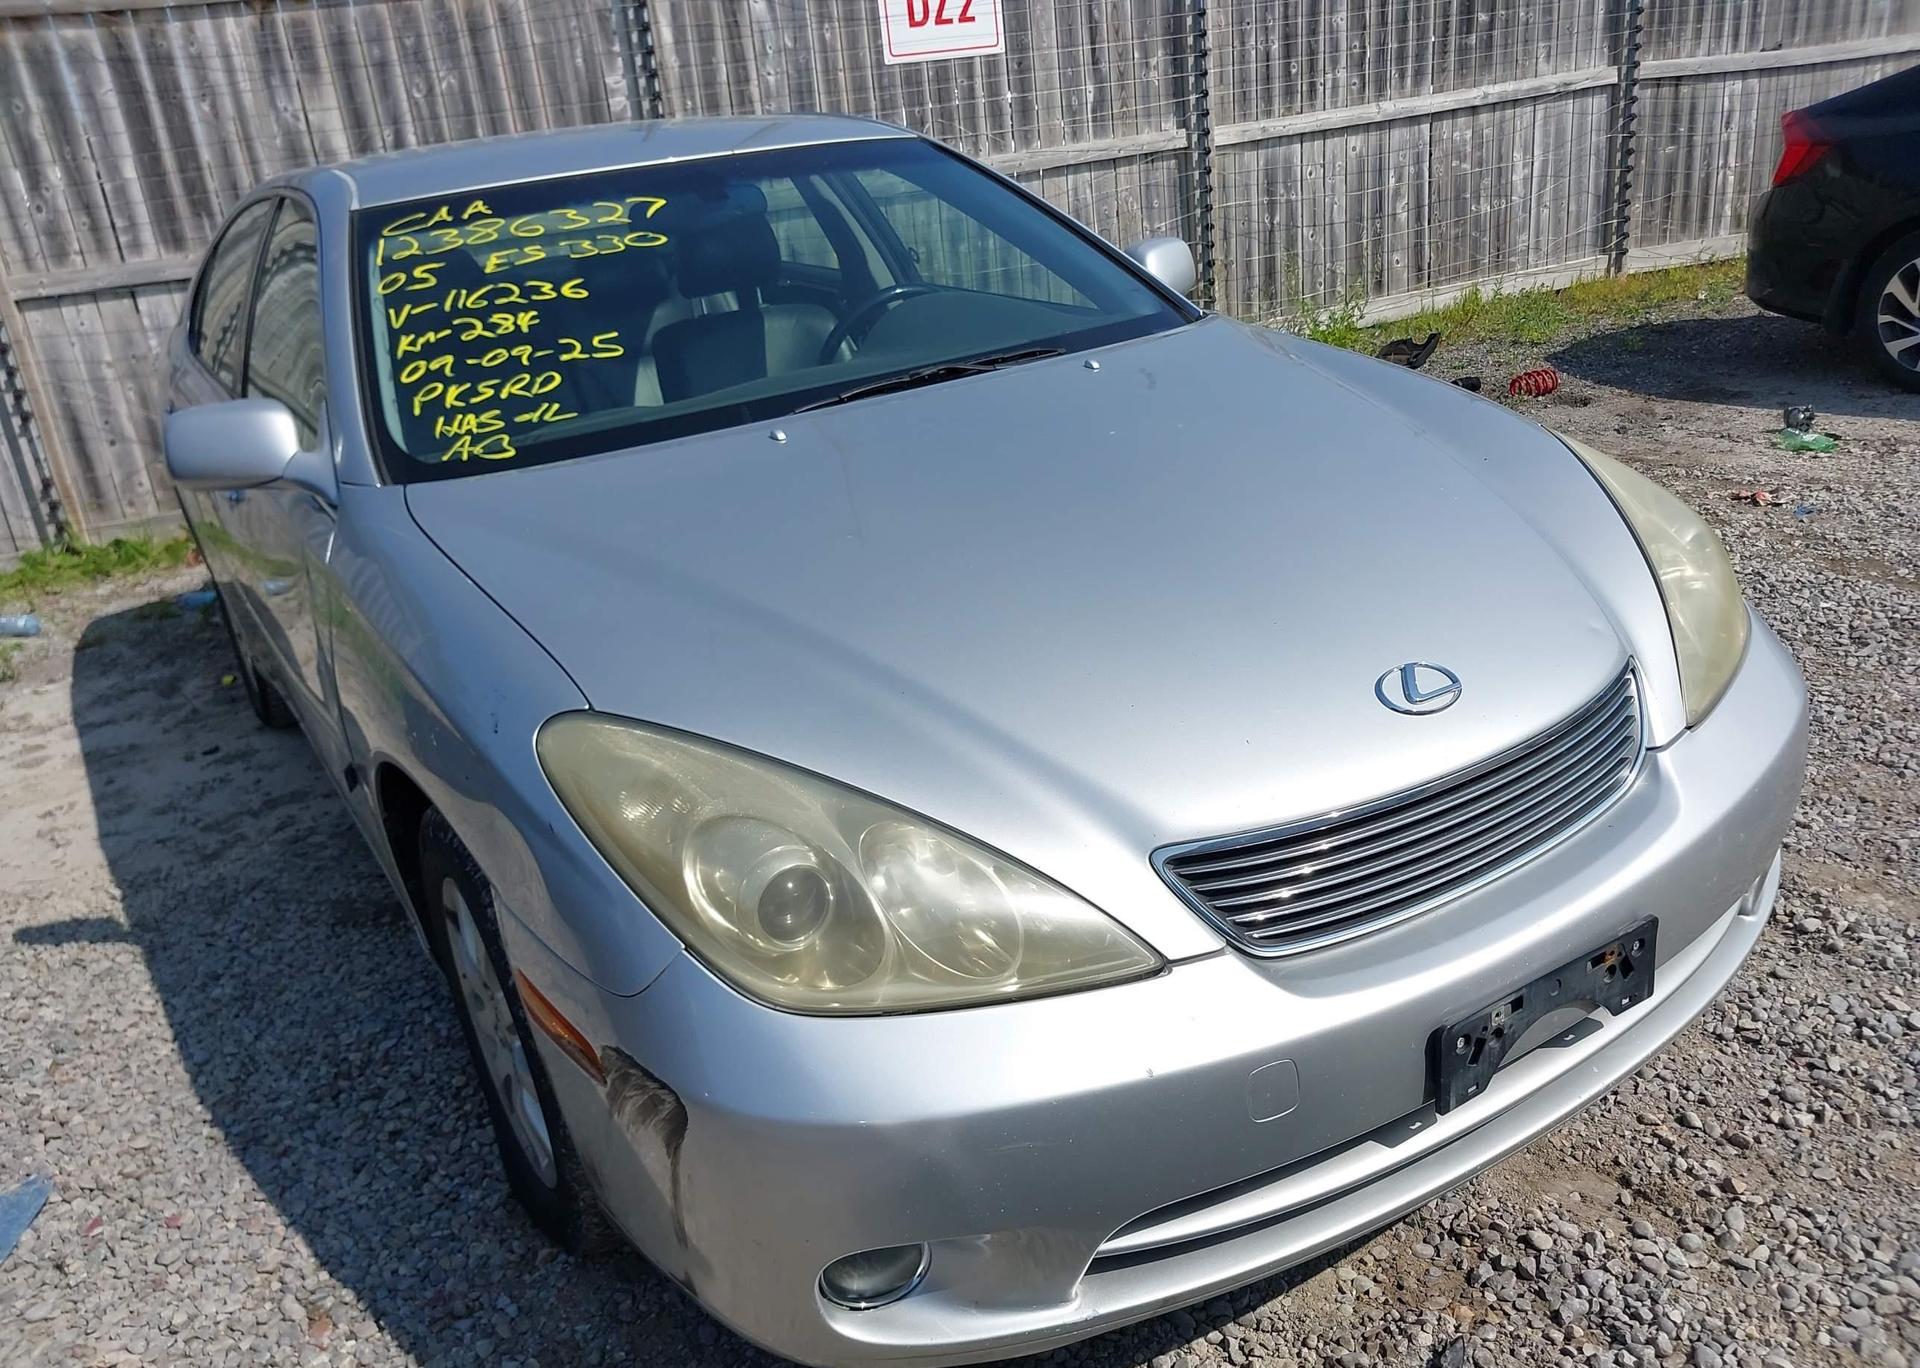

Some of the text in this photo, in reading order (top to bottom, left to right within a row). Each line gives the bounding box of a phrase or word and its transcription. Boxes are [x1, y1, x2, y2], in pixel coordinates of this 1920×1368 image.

[375, 197, 668, 266] 12386327
[377, 231, 669, 295] 05 ES 330
